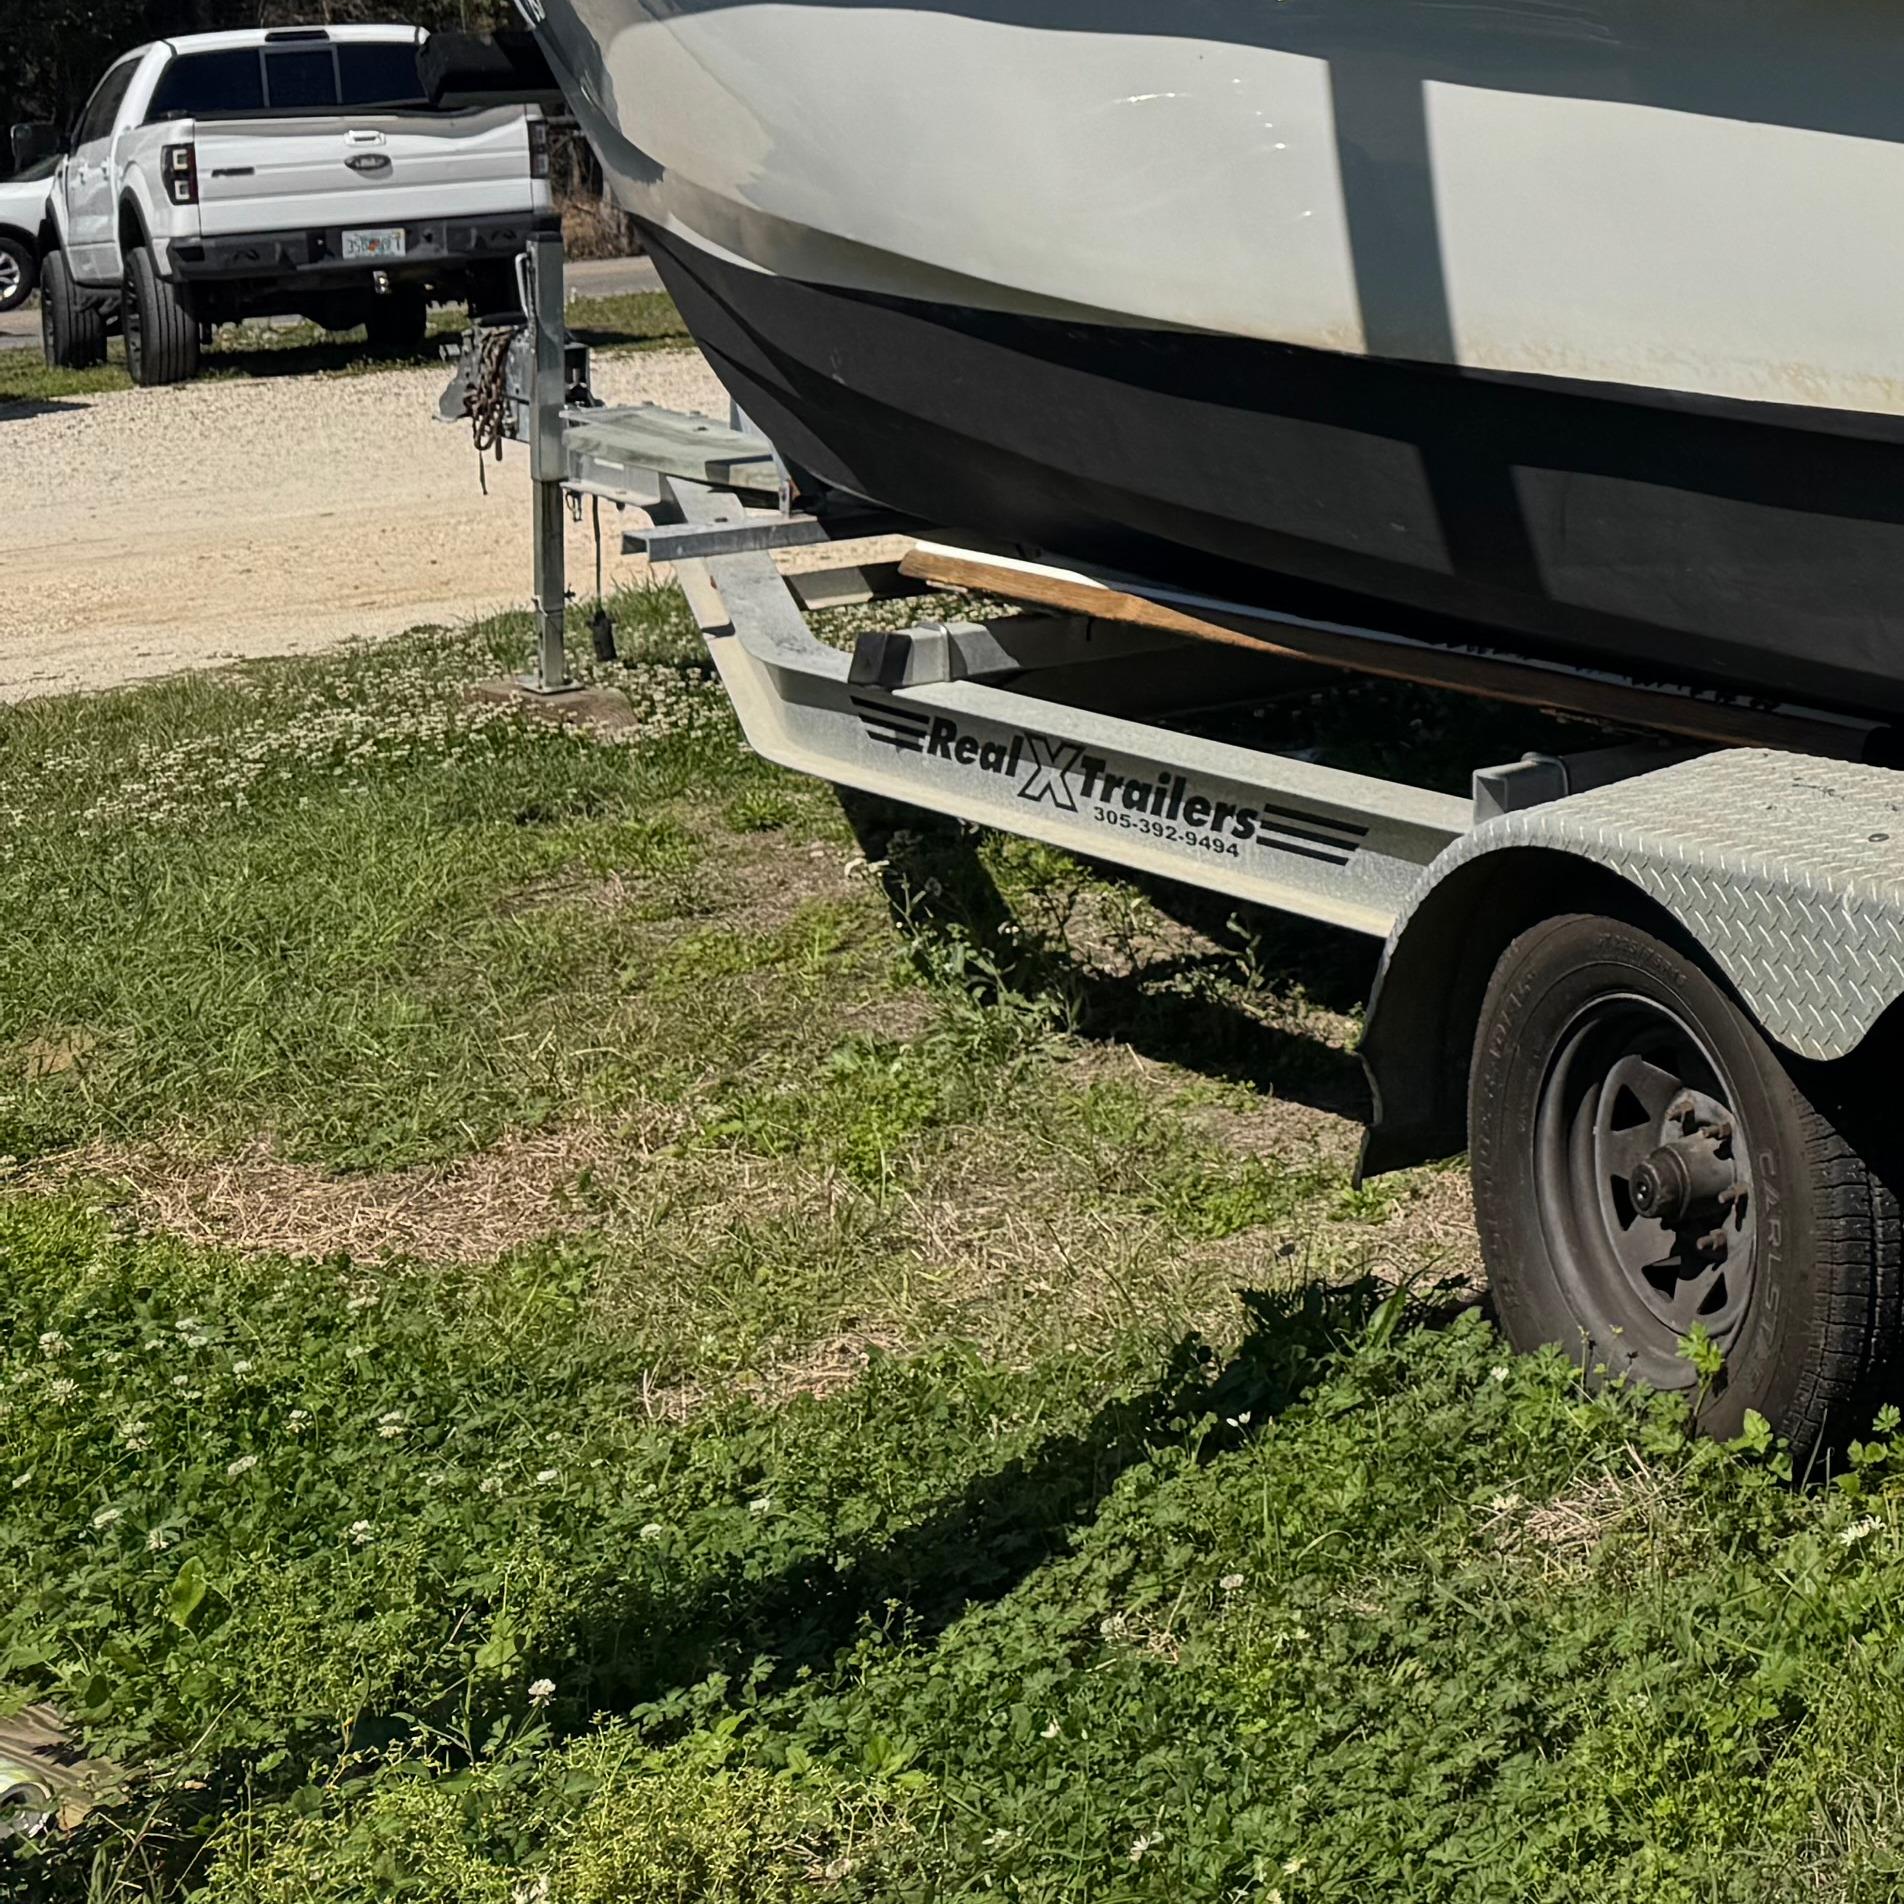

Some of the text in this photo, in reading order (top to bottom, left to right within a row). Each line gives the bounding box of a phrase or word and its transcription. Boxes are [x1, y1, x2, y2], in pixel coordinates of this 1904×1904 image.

[927, 717, 1022, 778] Real
[1079, 757, 1260, 840] Trailers
[1093, 806, 1239, 858] 305-392-9494
